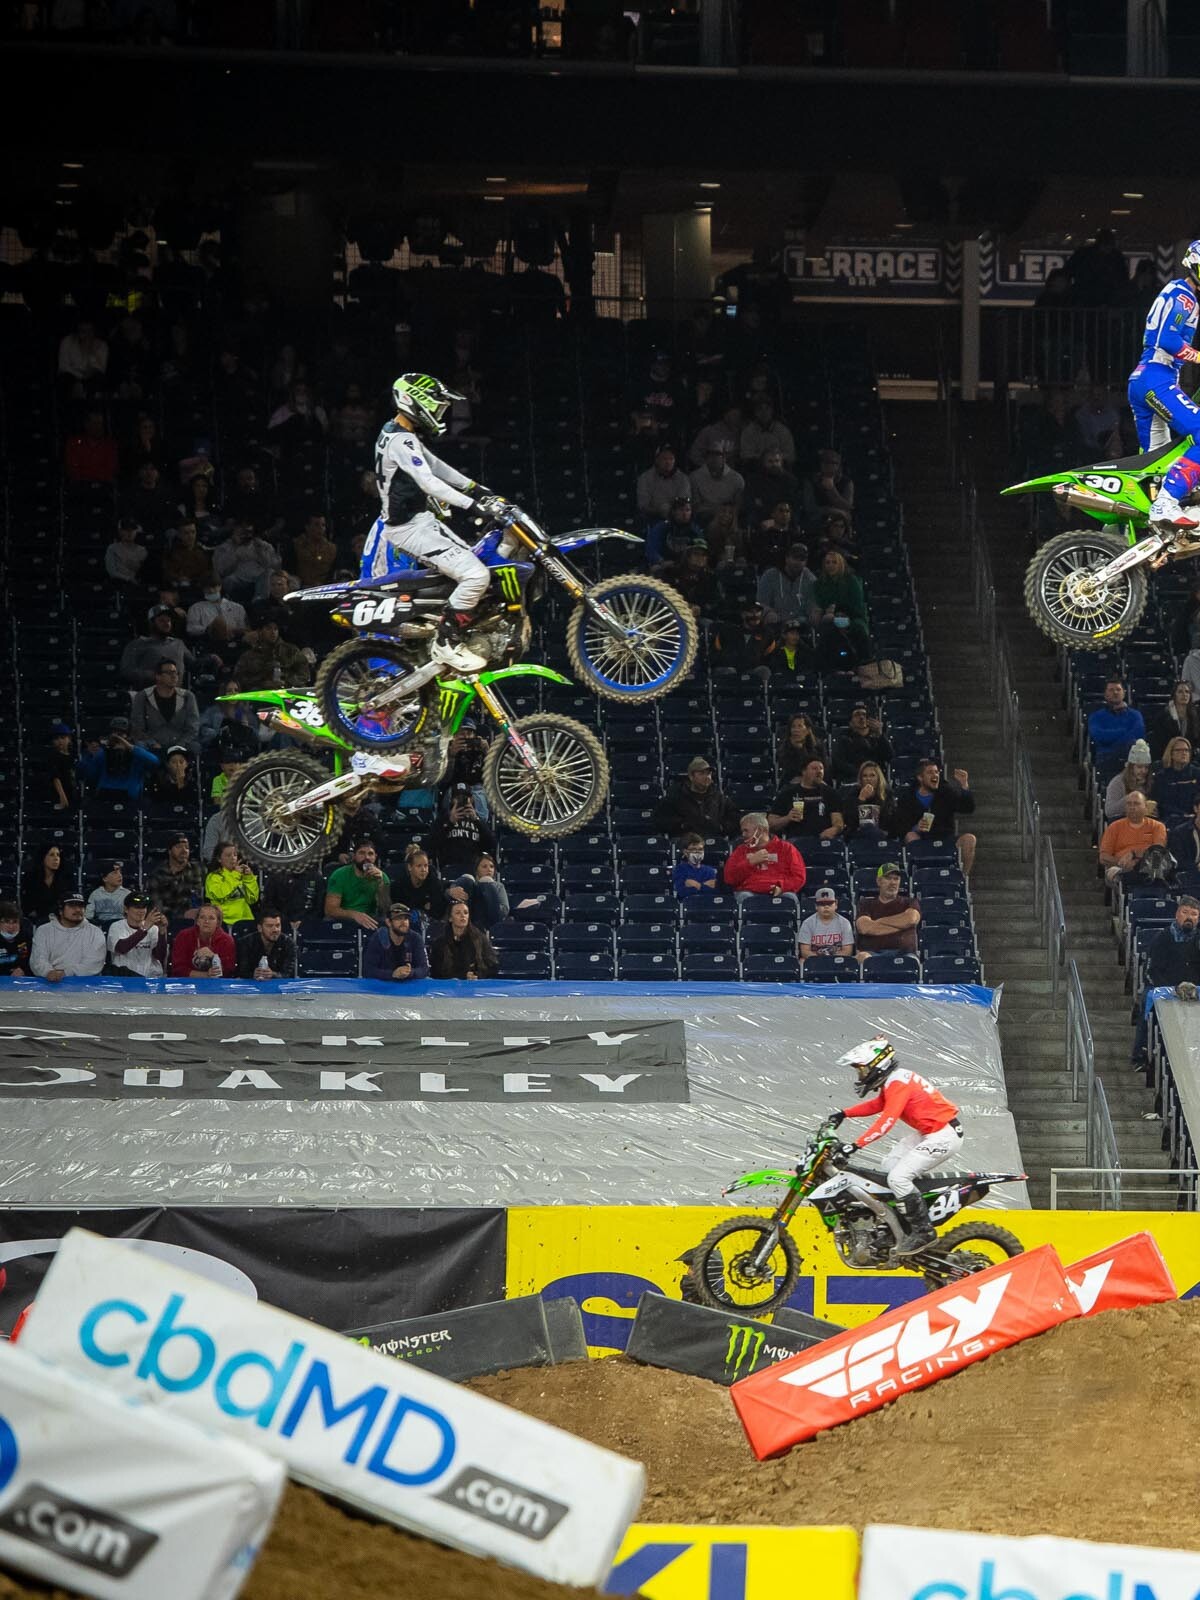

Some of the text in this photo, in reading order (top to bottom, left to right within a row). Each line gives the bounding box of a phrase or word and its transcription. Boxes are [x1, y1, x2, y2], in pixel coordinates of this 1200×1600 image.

[1084, 474, 1122, 493] 30
[352, 597, 397, 626] 64
[123, 1066, 646, 1093] OAKLEY
[928, 1190, 961, 1222] 84
[778, 1272, 1012, 1398] FLY
[849, 1340, 985, 1409] RACING
[78, 1294, 458, 1486] cbdMD
[455, 1479, 549, 1534] .com
[14, 1499, 132, 1568] .com
